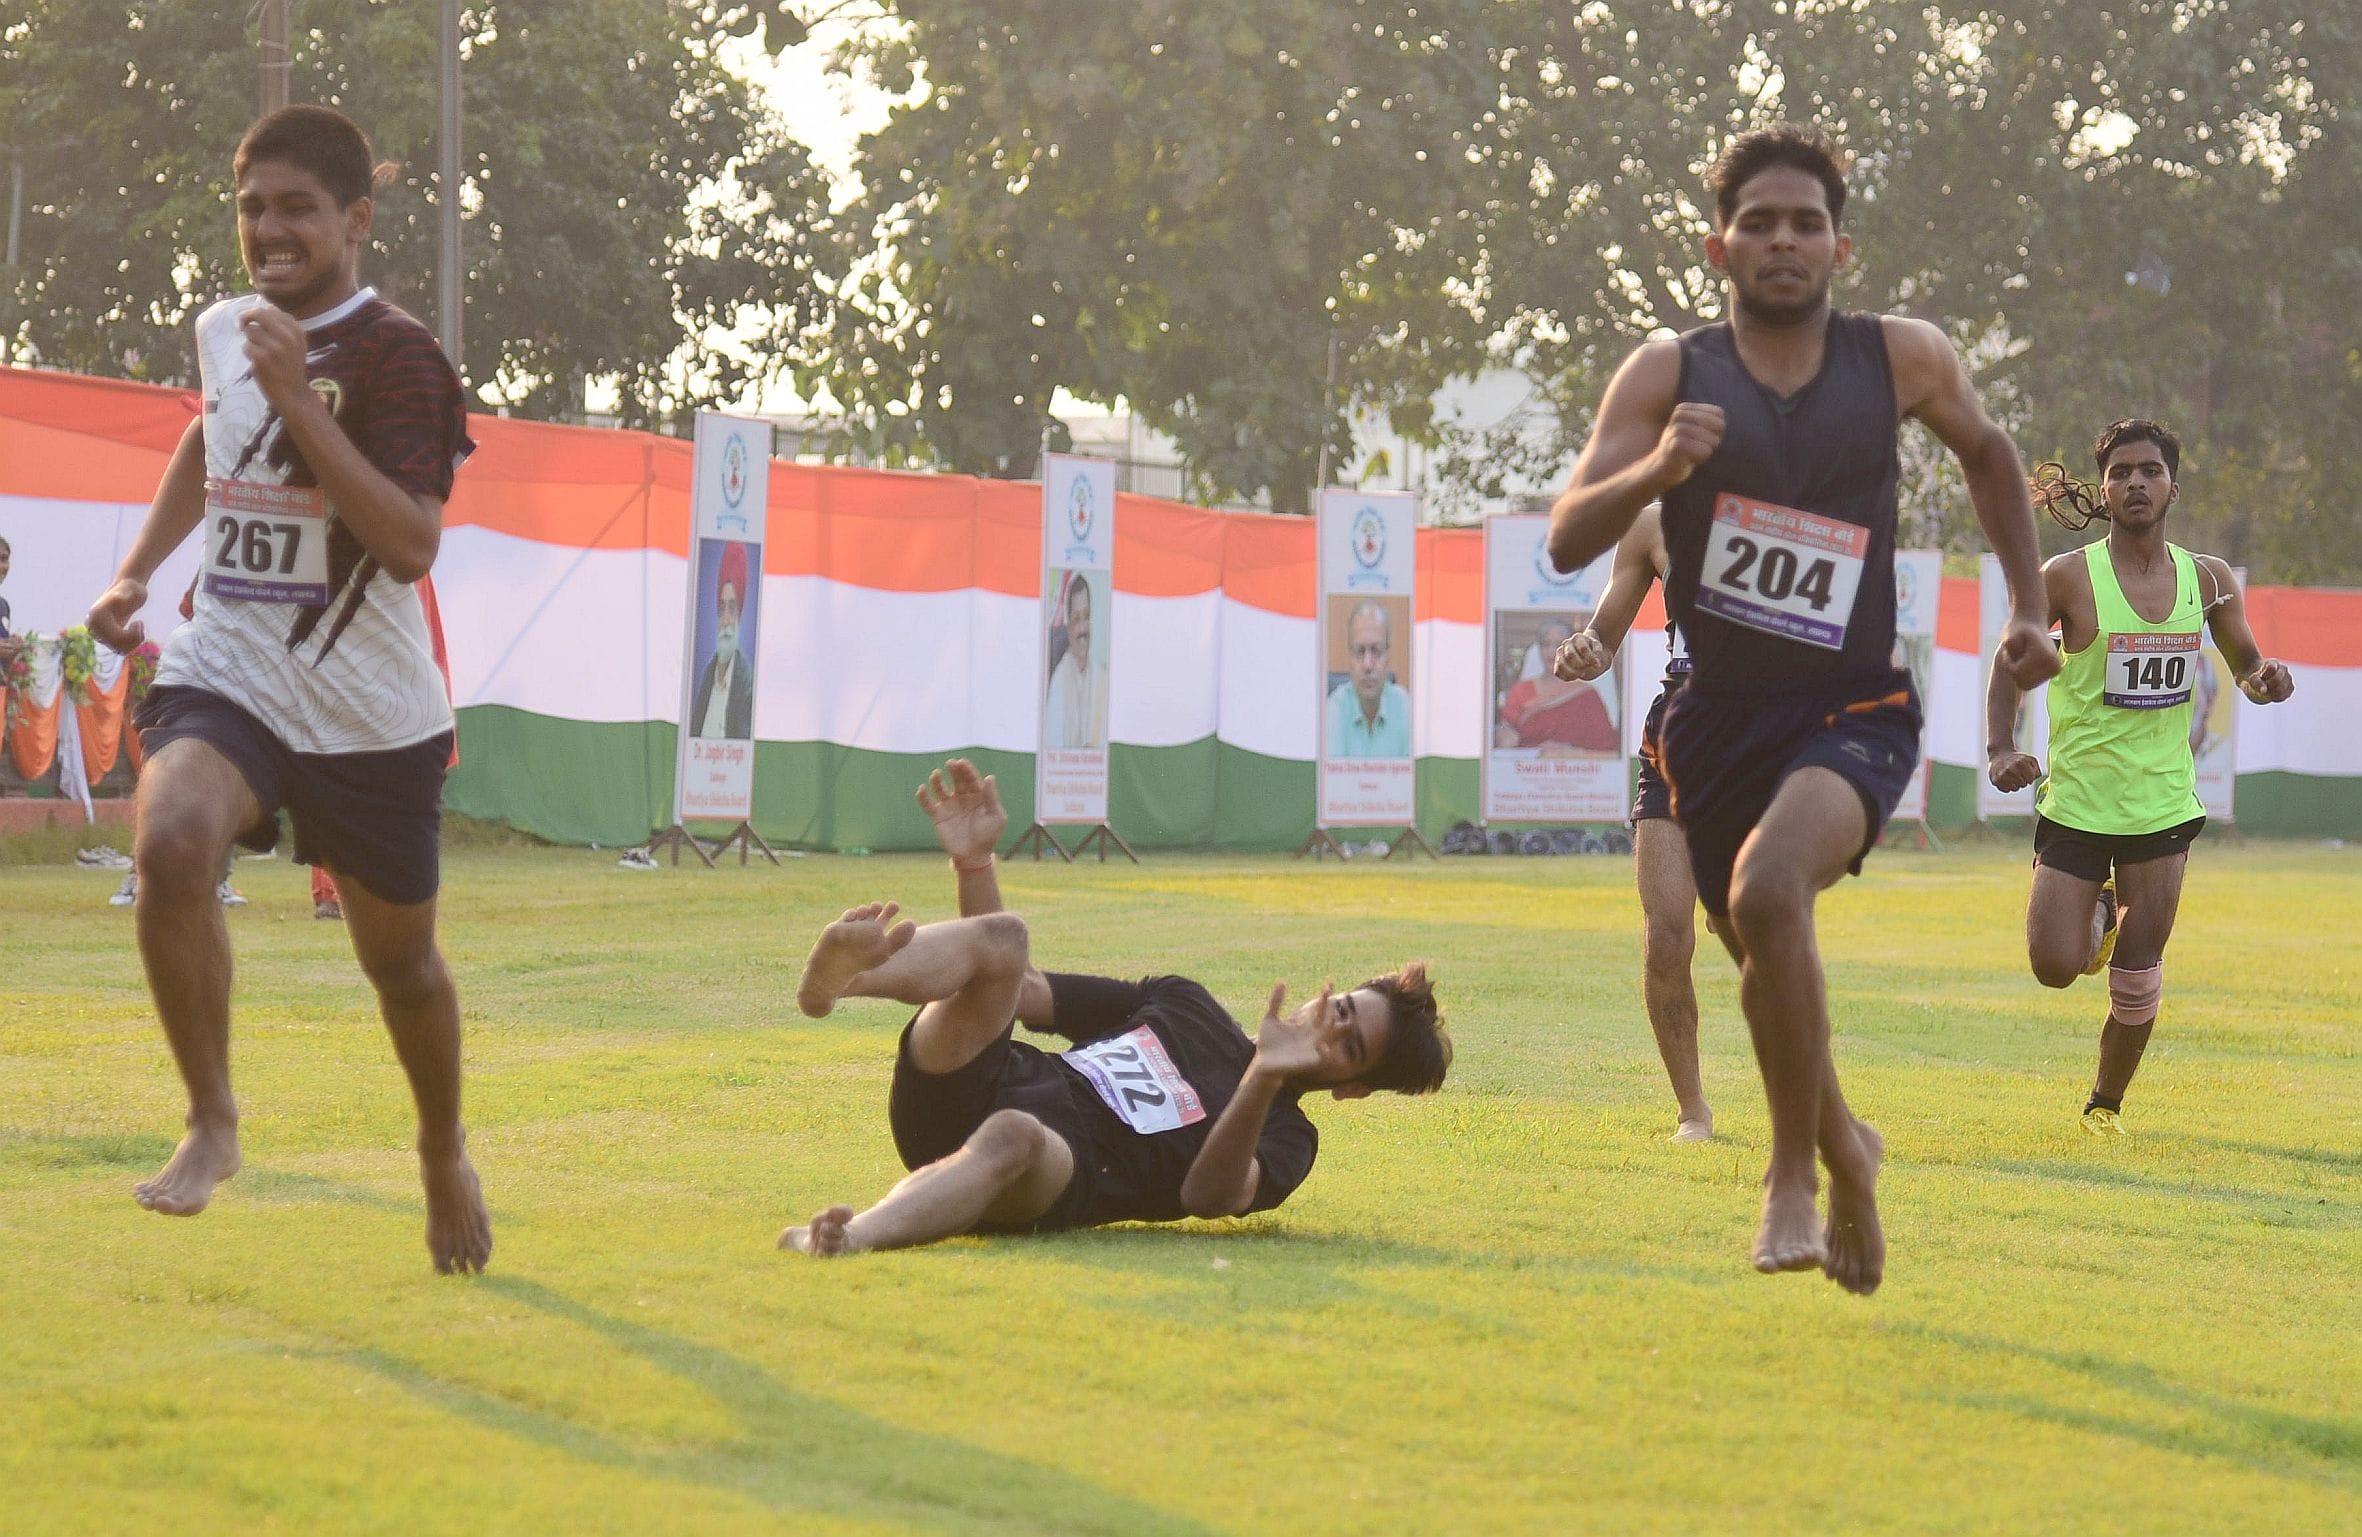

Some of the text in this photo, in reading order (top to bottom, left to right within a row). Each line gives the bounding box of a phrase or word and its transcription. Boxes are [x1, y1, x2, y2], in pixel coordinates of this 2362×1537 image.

[216, 515, 302, 574] 267
[1752, 507, 1797, 529] भारतीय
[1799, 517, 1832, 537] शिक्षा
[1834, 526, 1856, 543] बोर्ड
[1719, 536, 1836, 612] 204
[2134, 634, 2162, 645] भारतीय
[2163, 634, 2184, 645] शिक्षा
[2122, 656, 2186, 690] 140
[1095, 1045, 1167, 1113] 272
